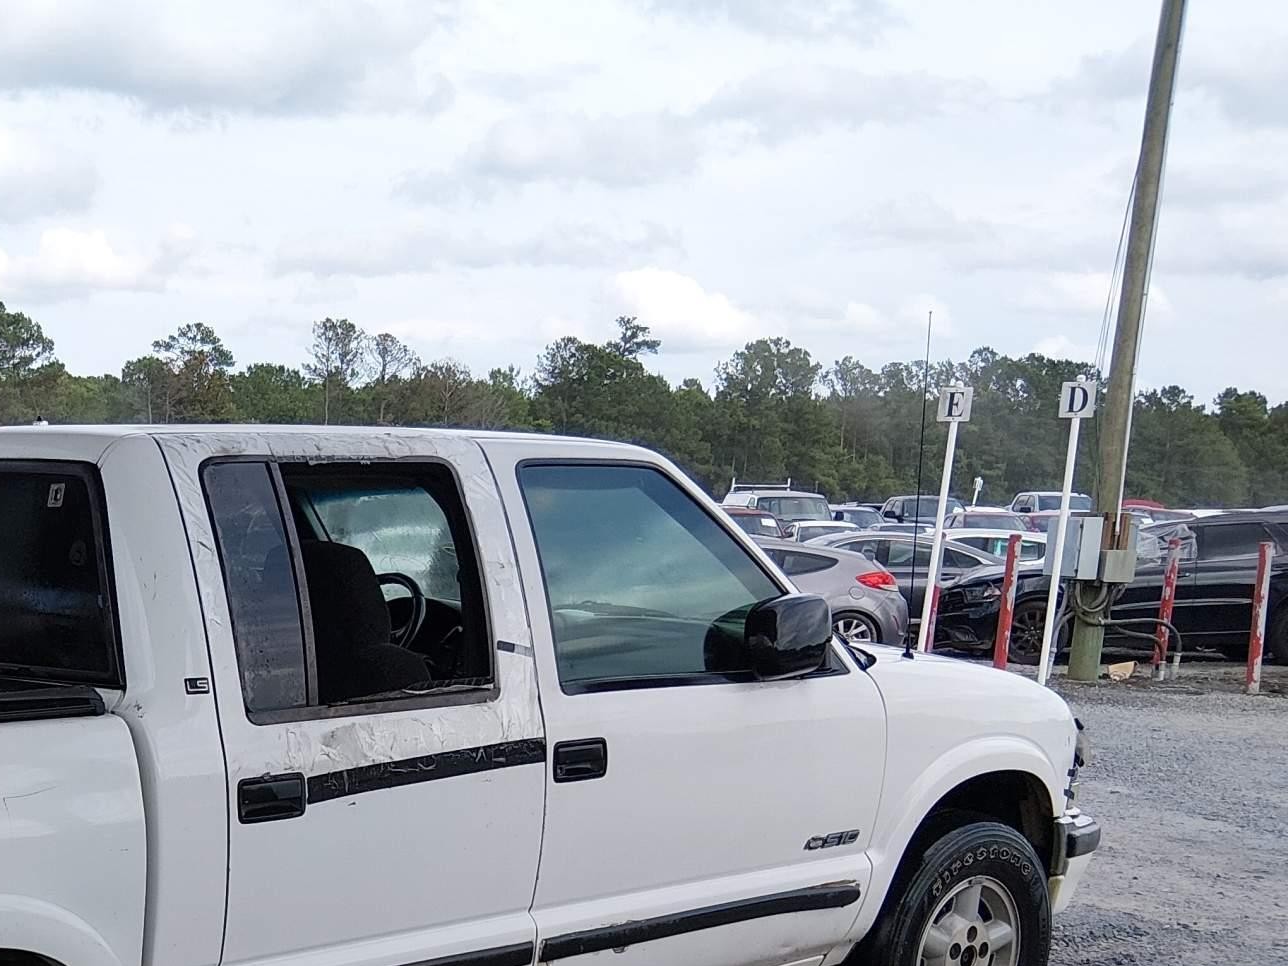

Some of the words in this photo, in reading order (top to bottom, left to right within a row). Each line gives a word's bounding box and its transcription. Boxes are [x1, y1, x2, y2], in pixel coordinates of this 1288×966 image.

[944, 391, 965, 418] E
[1067, 386, 1089, 414] D
[186, 679, 209, 692] LS
[932, 845, 1033, 897] Firestone
